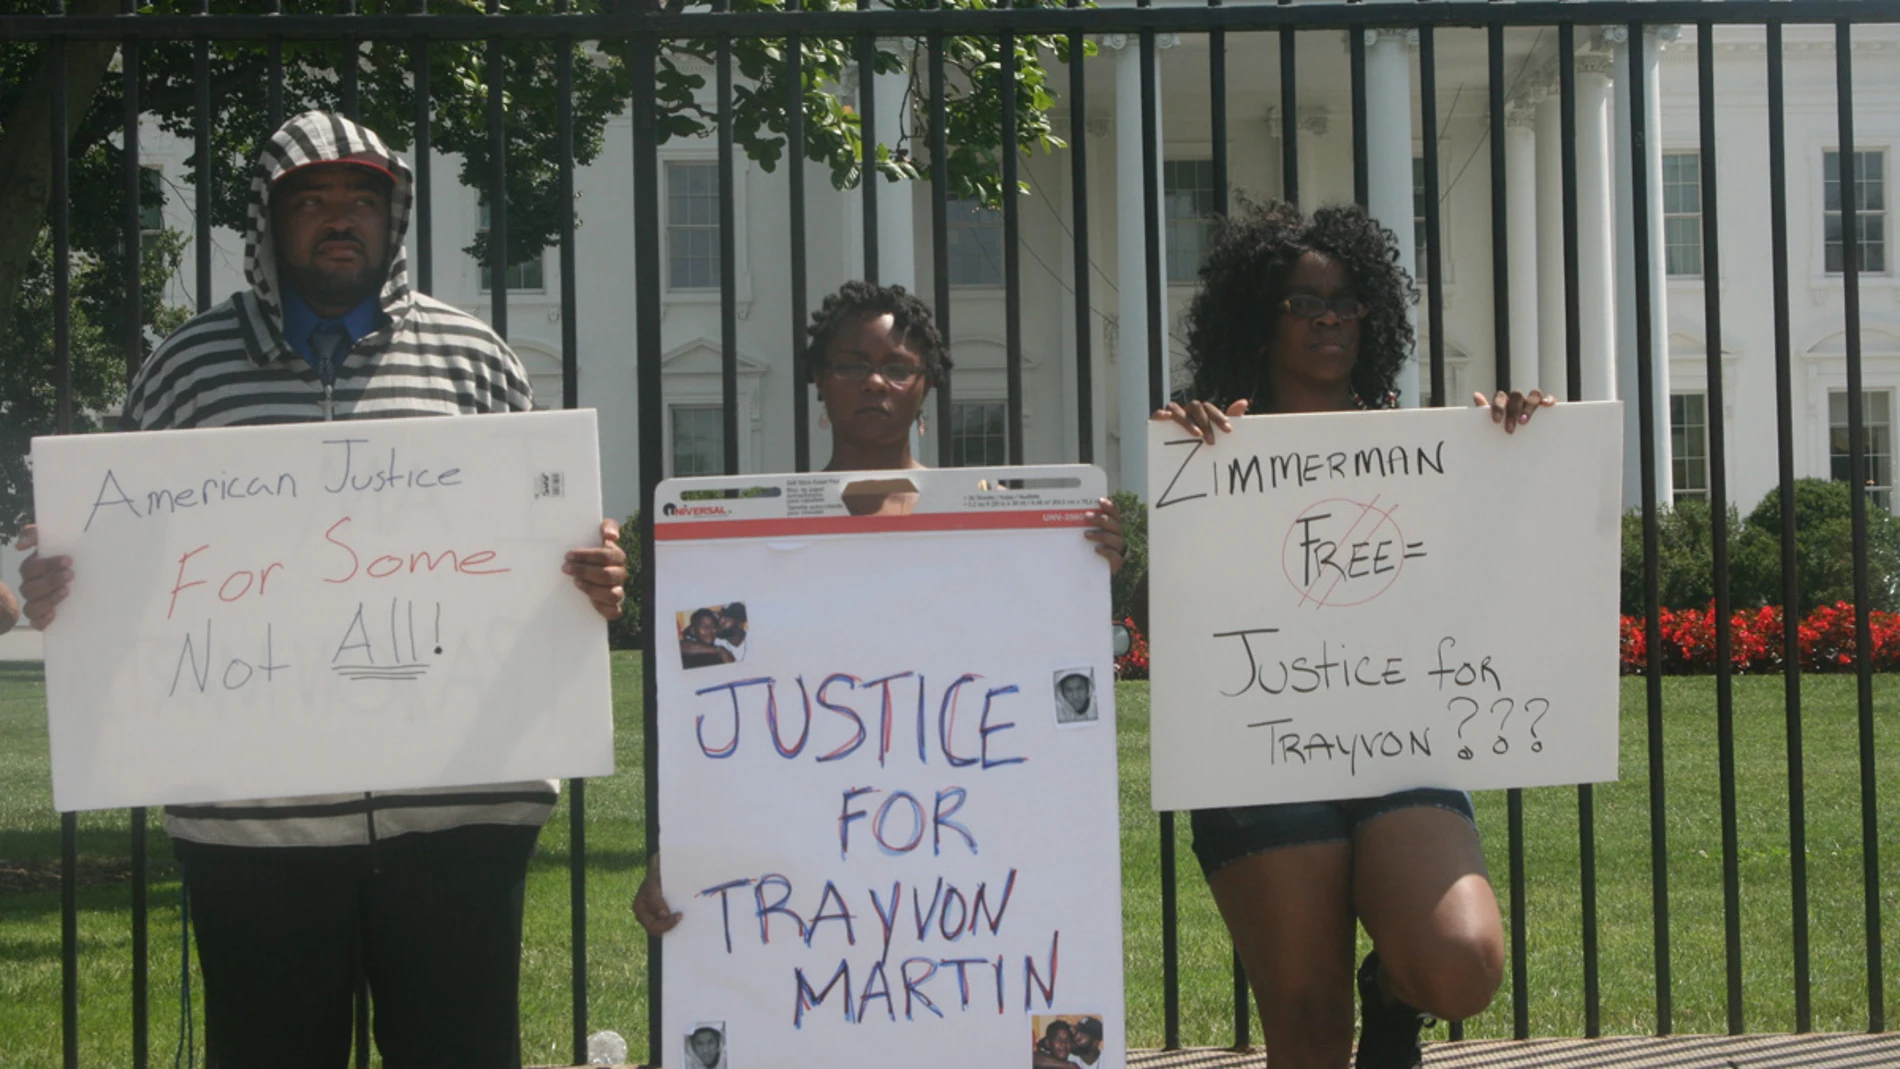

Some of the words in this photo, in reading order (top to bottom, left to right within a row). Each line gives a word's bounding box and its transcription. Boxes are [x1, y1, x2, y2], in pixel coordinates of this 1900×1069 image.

[84, 469, 297, 532] American
[323, 439, 463, 494] Justice
[1156, 438, 1446, 509] ZIMMERMAN
[167, 544, 284, 619] For
[323, 516, 512, 584] Some
[169, 618, 290, 697] Not
[331, 597, 444, 663] All!
[696, 671, 1028, 768] JUSTICE
[1247, 718, 1432, 776] TRAYVON
[838, 786, 978, 859] FOR
[694, 868, 1017, 964] TRAYVON
[794, 930, 1059, 1028] MARTIN
